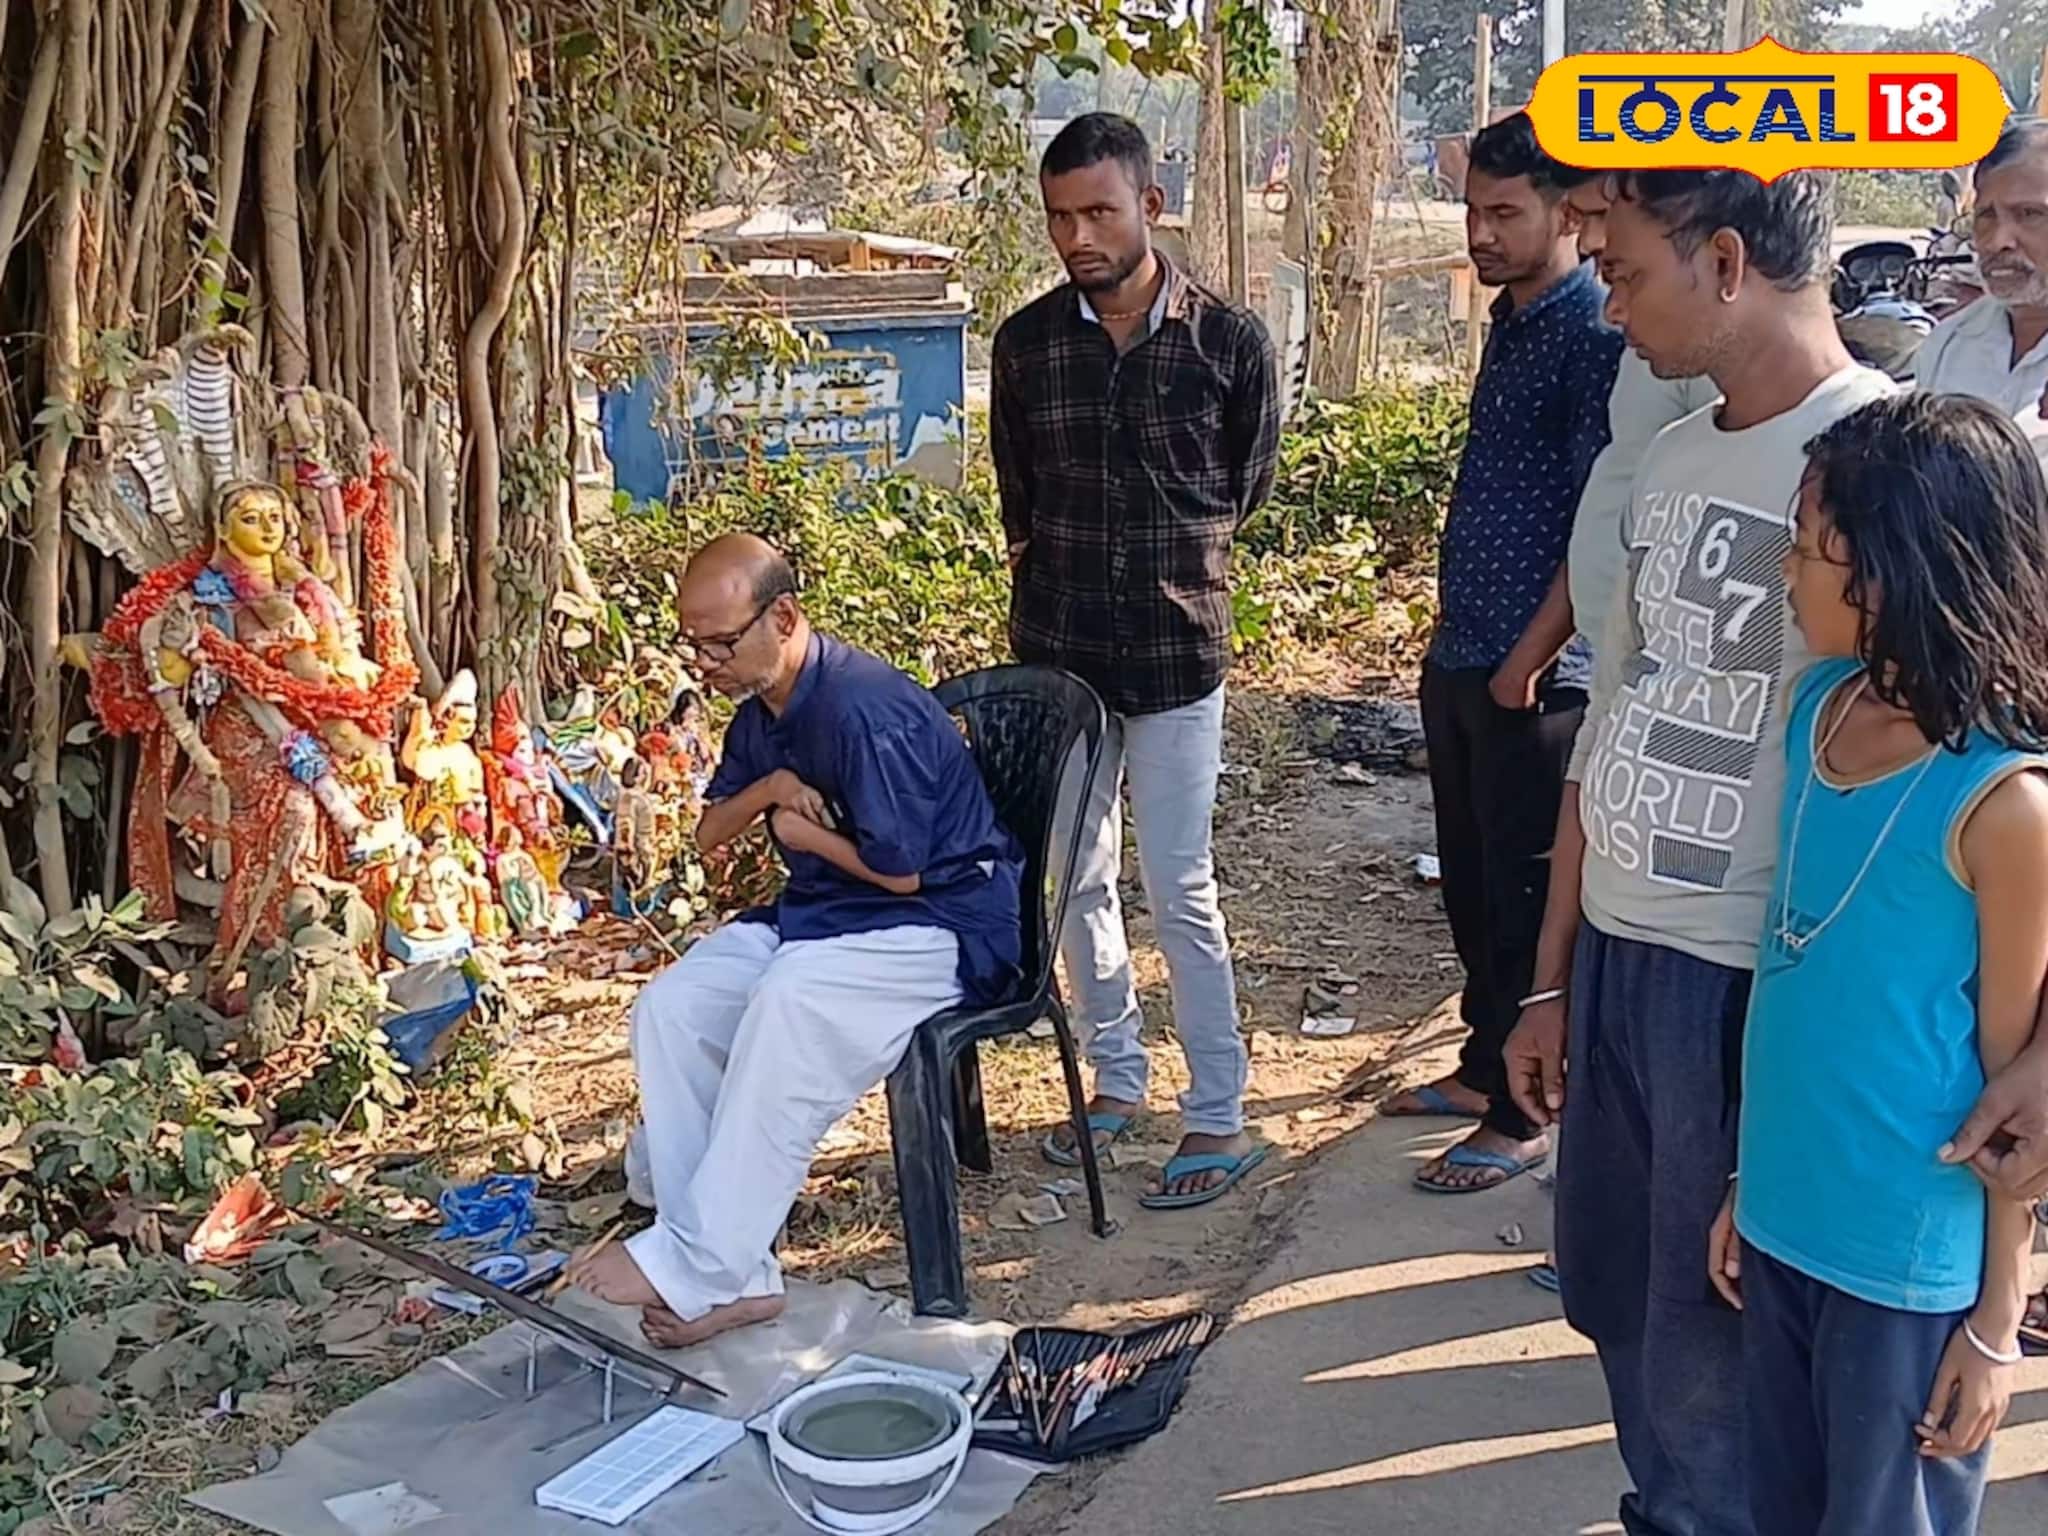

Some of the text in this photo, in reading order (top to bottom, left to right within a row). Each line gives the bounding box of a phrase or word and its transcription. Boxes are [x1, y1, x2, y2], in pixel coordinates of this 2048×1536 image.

[1633, 491, 1702, 545] THIS
[1698, 517, 1739, 580] 6
[1720, 578, 1768, 643] 7
